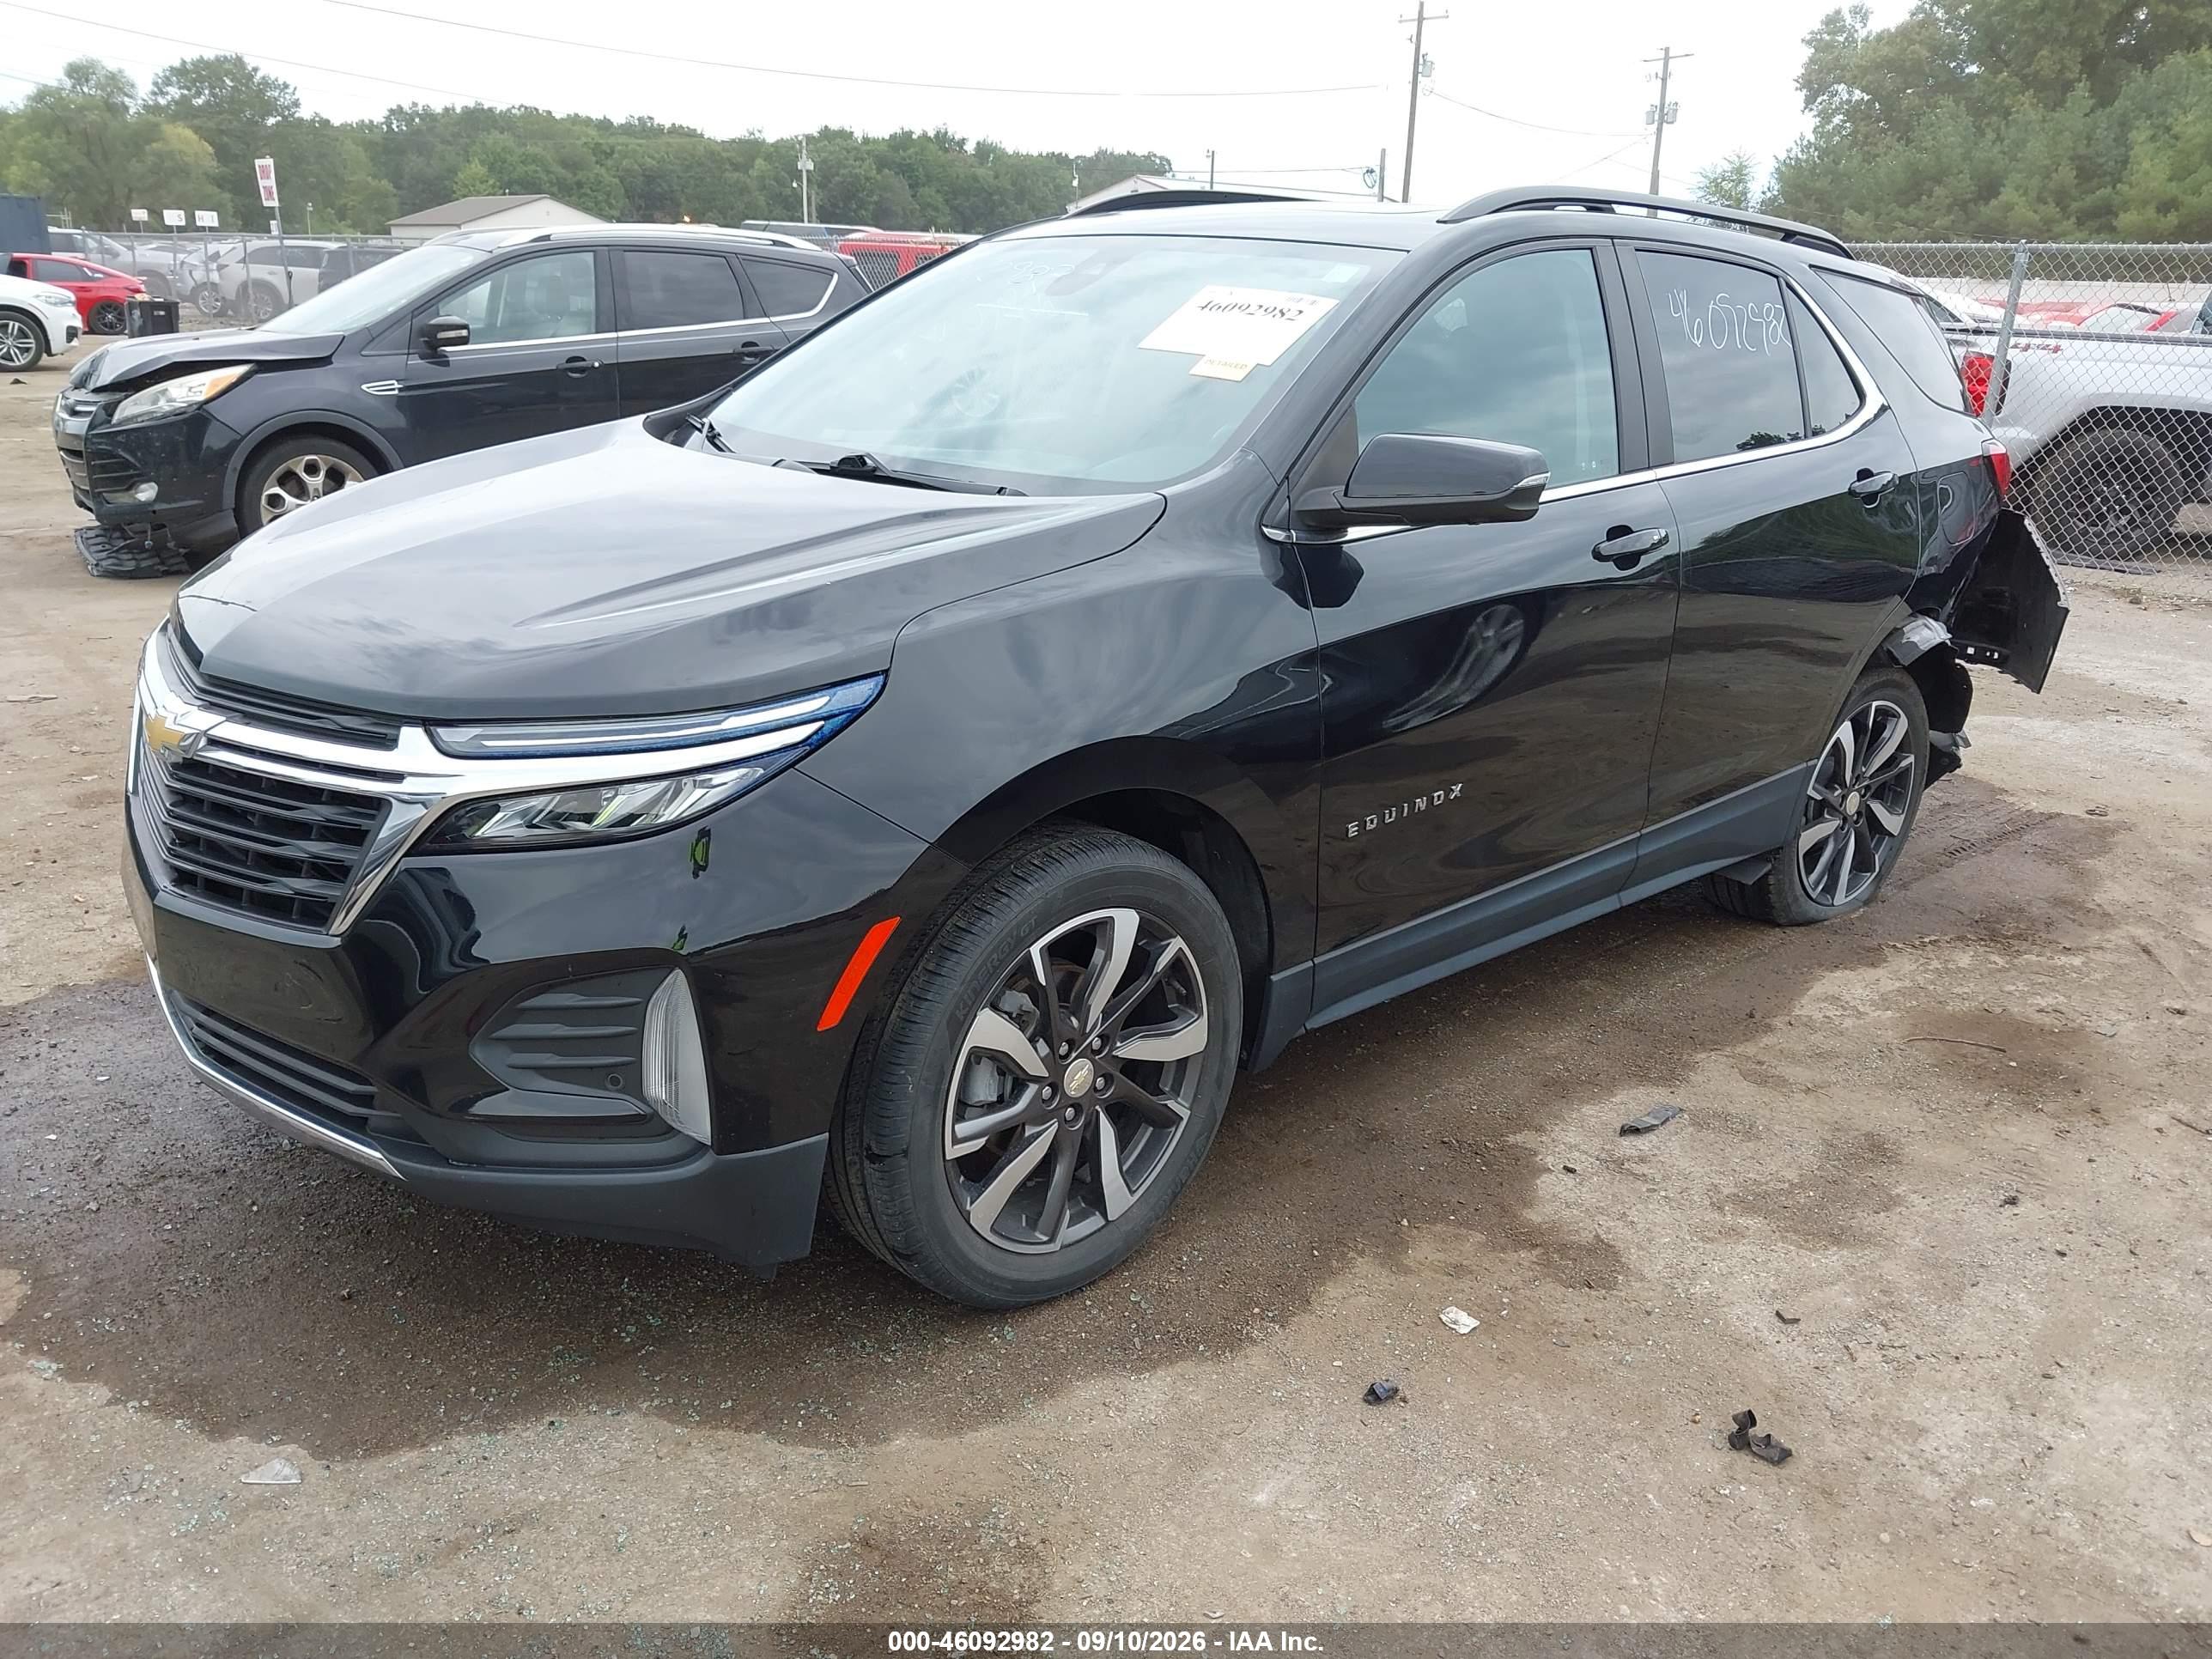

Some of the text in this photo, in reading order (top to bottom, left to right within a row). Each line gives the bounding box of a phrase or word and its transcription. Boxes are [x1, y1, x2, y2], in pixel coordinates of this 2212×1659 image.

[258, 164, 271, 179] DROP
[263, 185, 275, 201] ZONE
[1195, 300, 1304, 321] 46092982
[1346, 783, 1463, 838] EQUINOX
